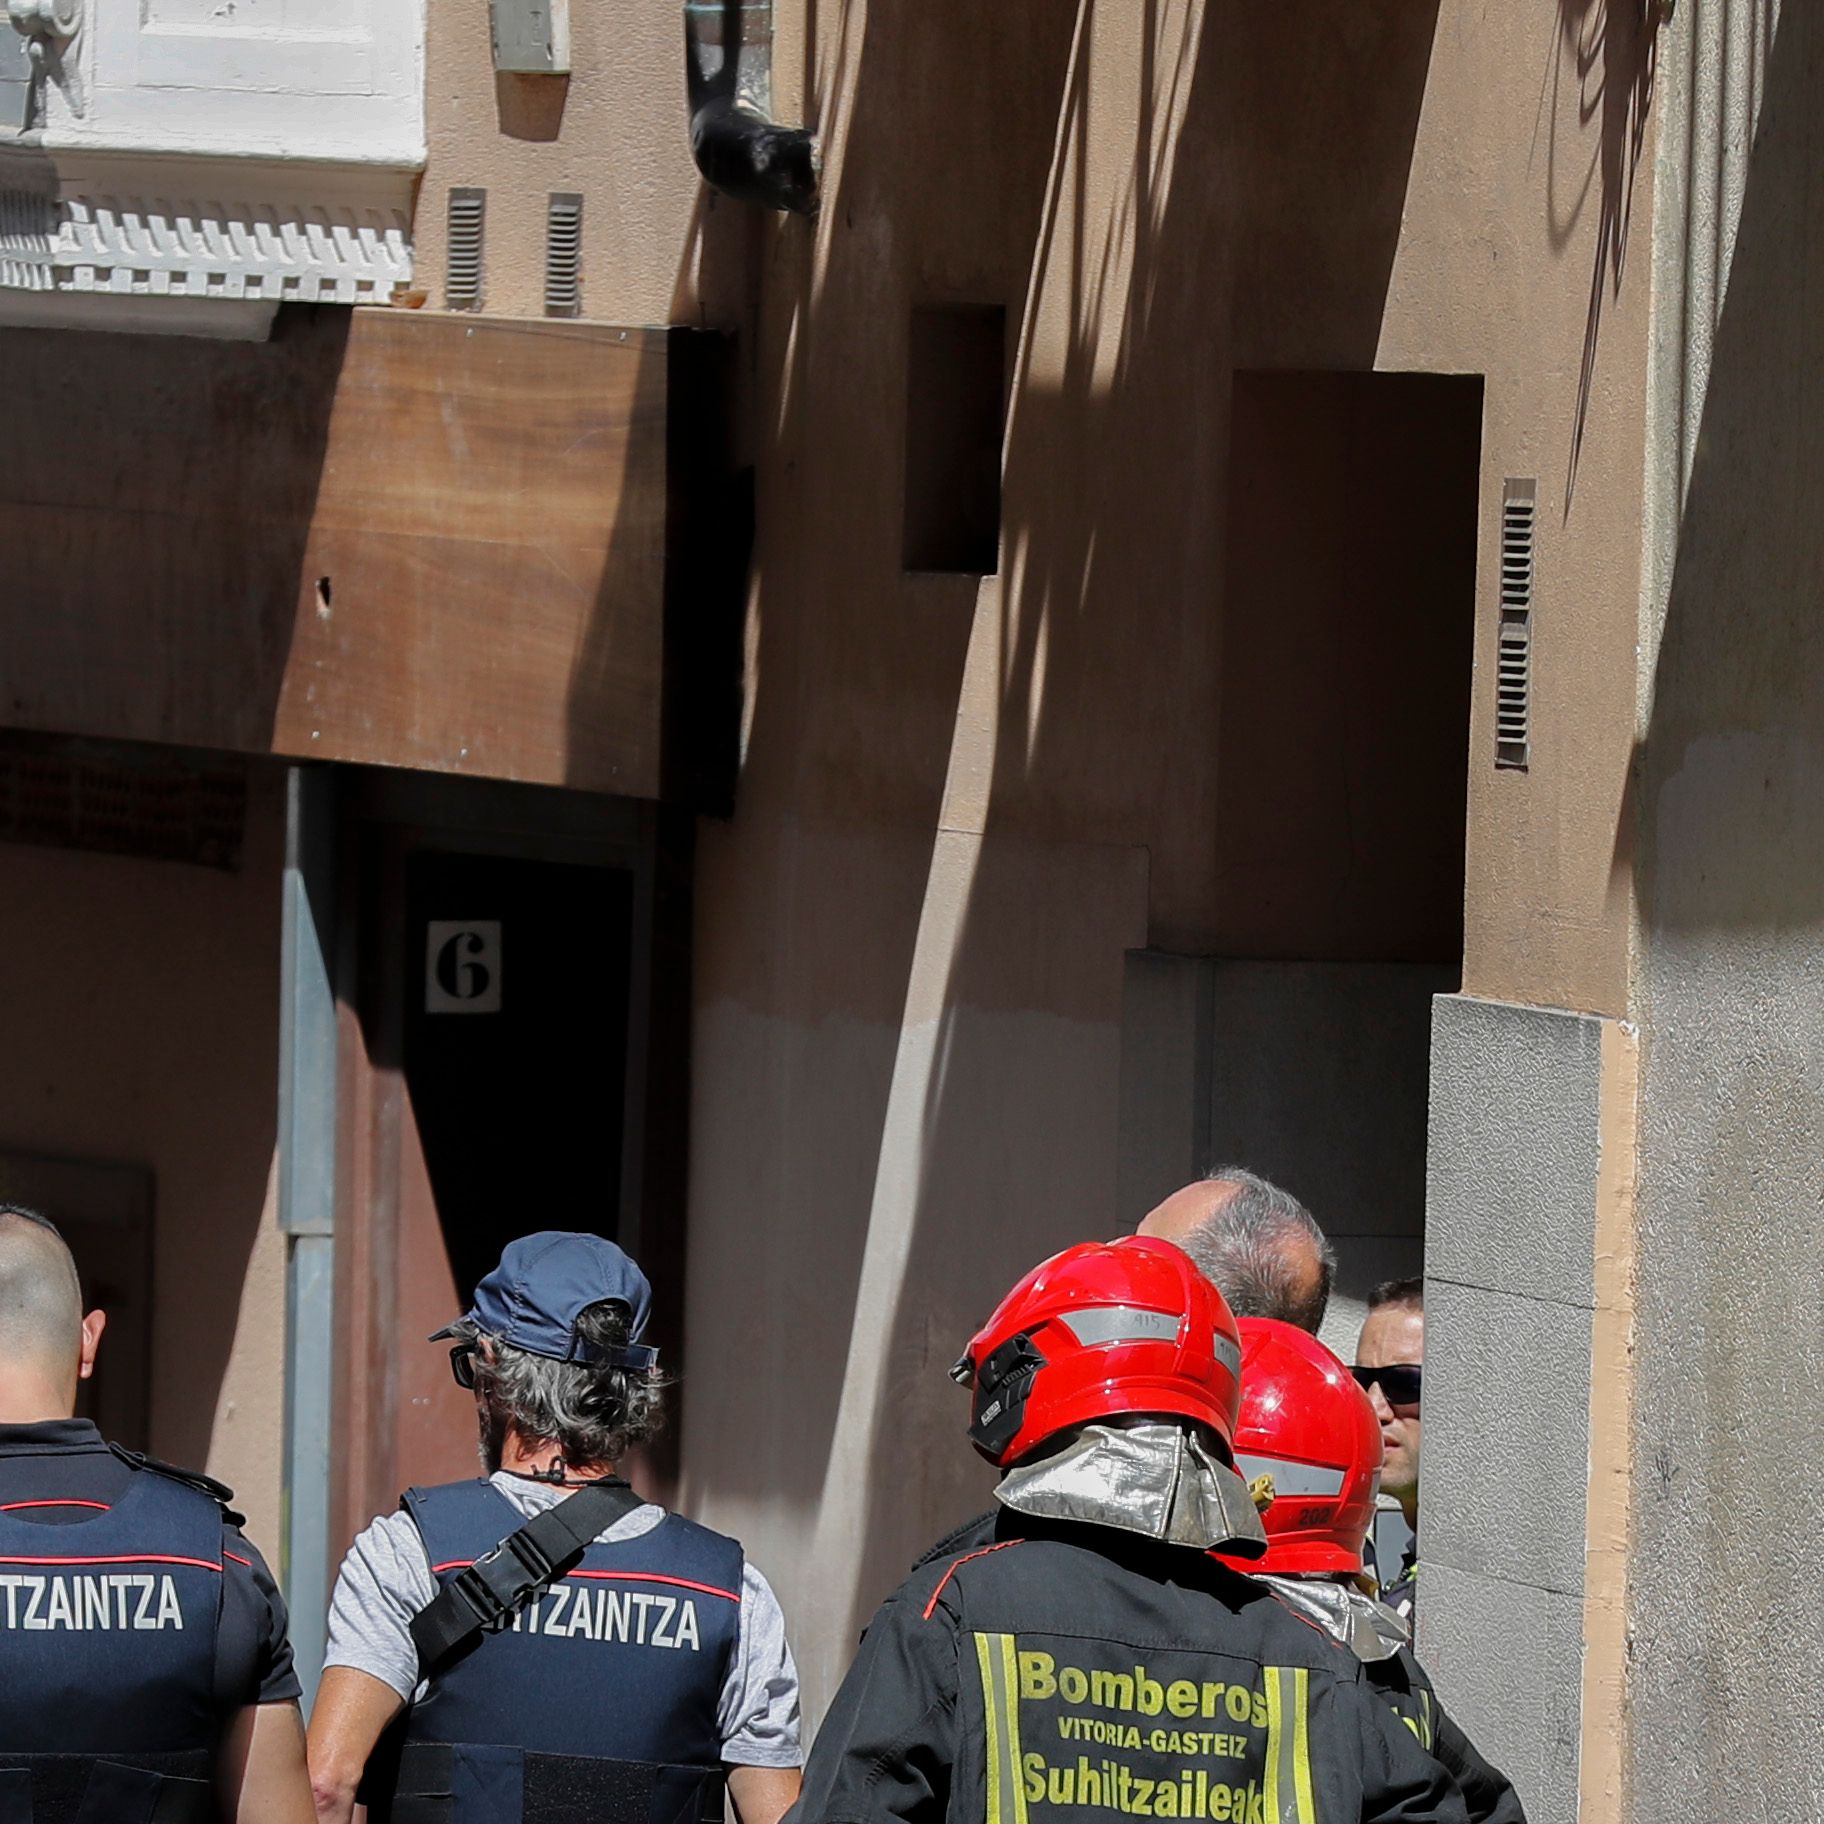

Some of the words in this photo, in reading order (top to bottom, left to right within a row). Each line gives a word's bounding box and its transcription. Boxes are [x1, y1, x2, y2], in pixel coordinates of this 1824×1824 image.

[437, 932, 490, 998] 6
[479, 1583, 701, 1652] TZAINTZA
[1018, 1651, 1268, 1729] Bomberos
[1057, 1716, 1248, 1760] VITORIA-GASTEIZ
